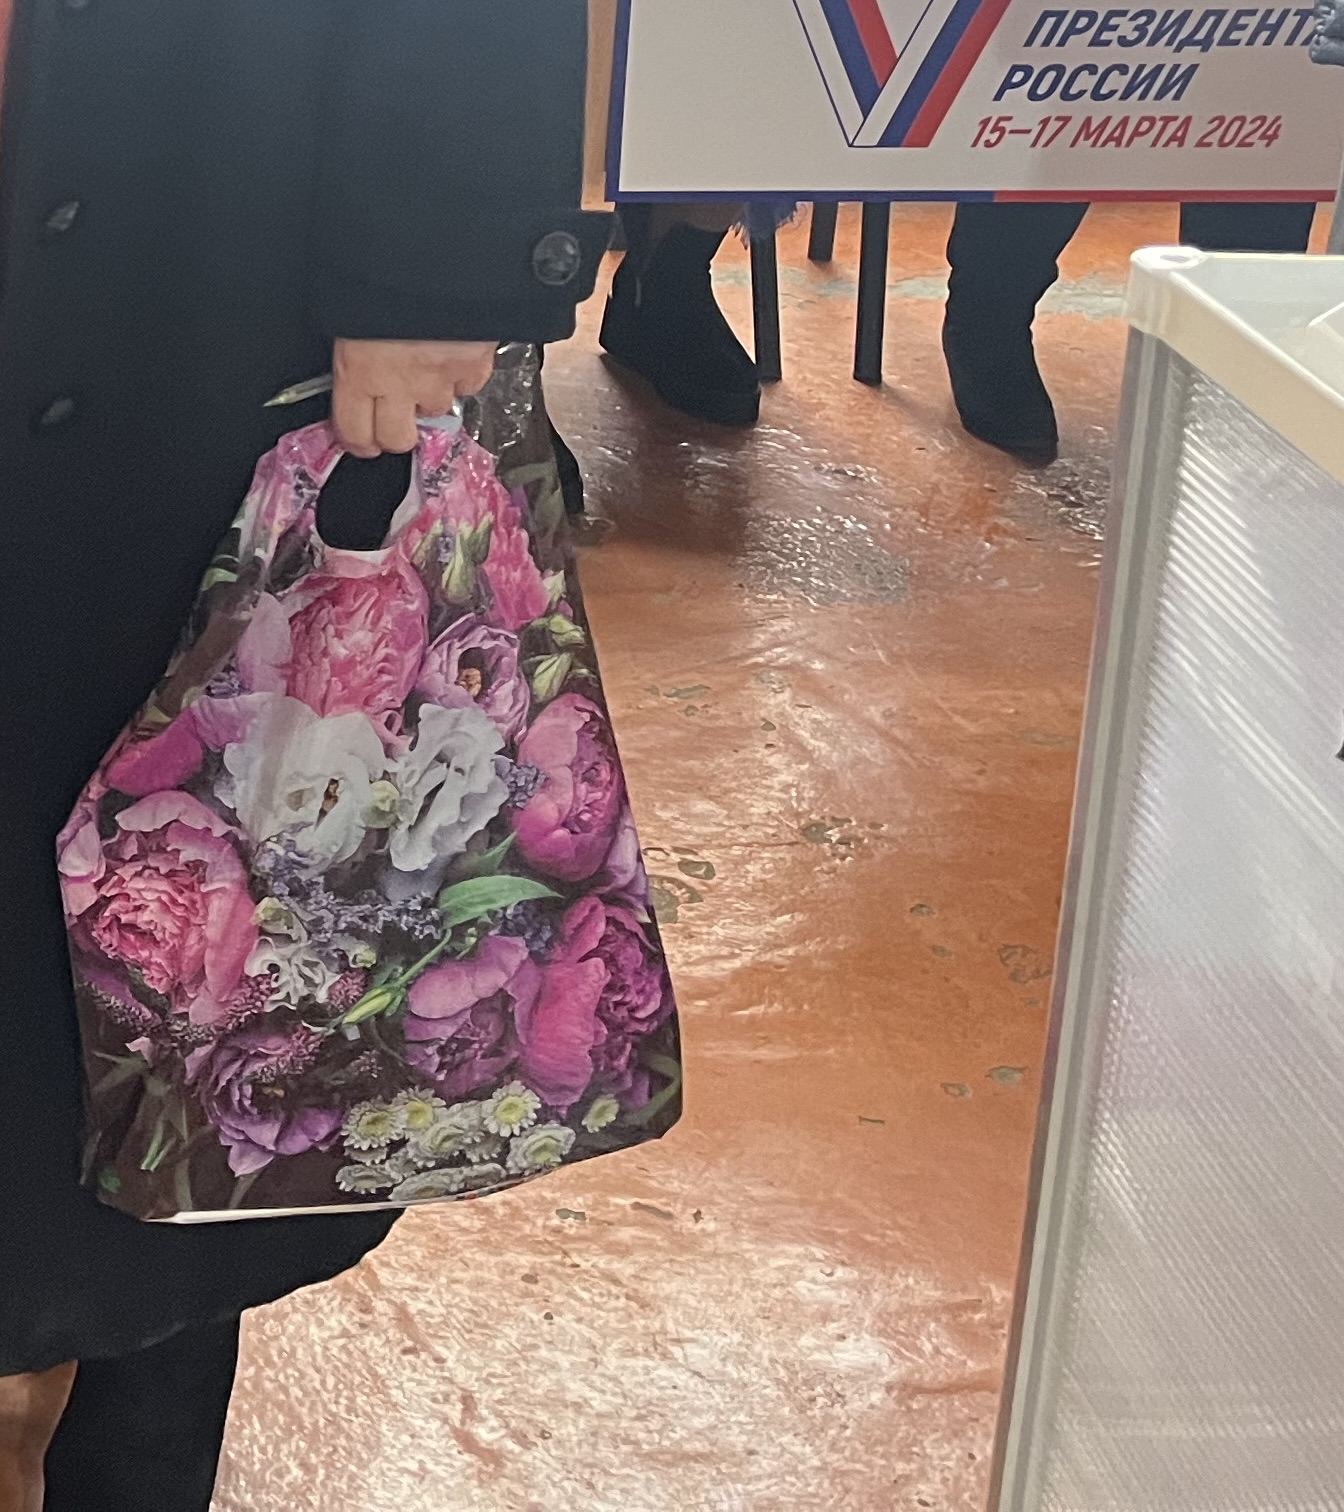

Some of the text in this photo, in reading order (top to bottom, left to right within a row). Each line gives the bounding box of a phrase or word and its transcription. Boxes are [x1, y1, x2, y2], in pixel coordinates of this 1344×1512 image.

[1023, 8, 1316, 54] ПРЕЗИДЕНТ
[992, 63, 1200, 102] РОССИИ
[1070, 115, 1193, 149] МАРТА
[1194, 114, 1283, 149] 2024
